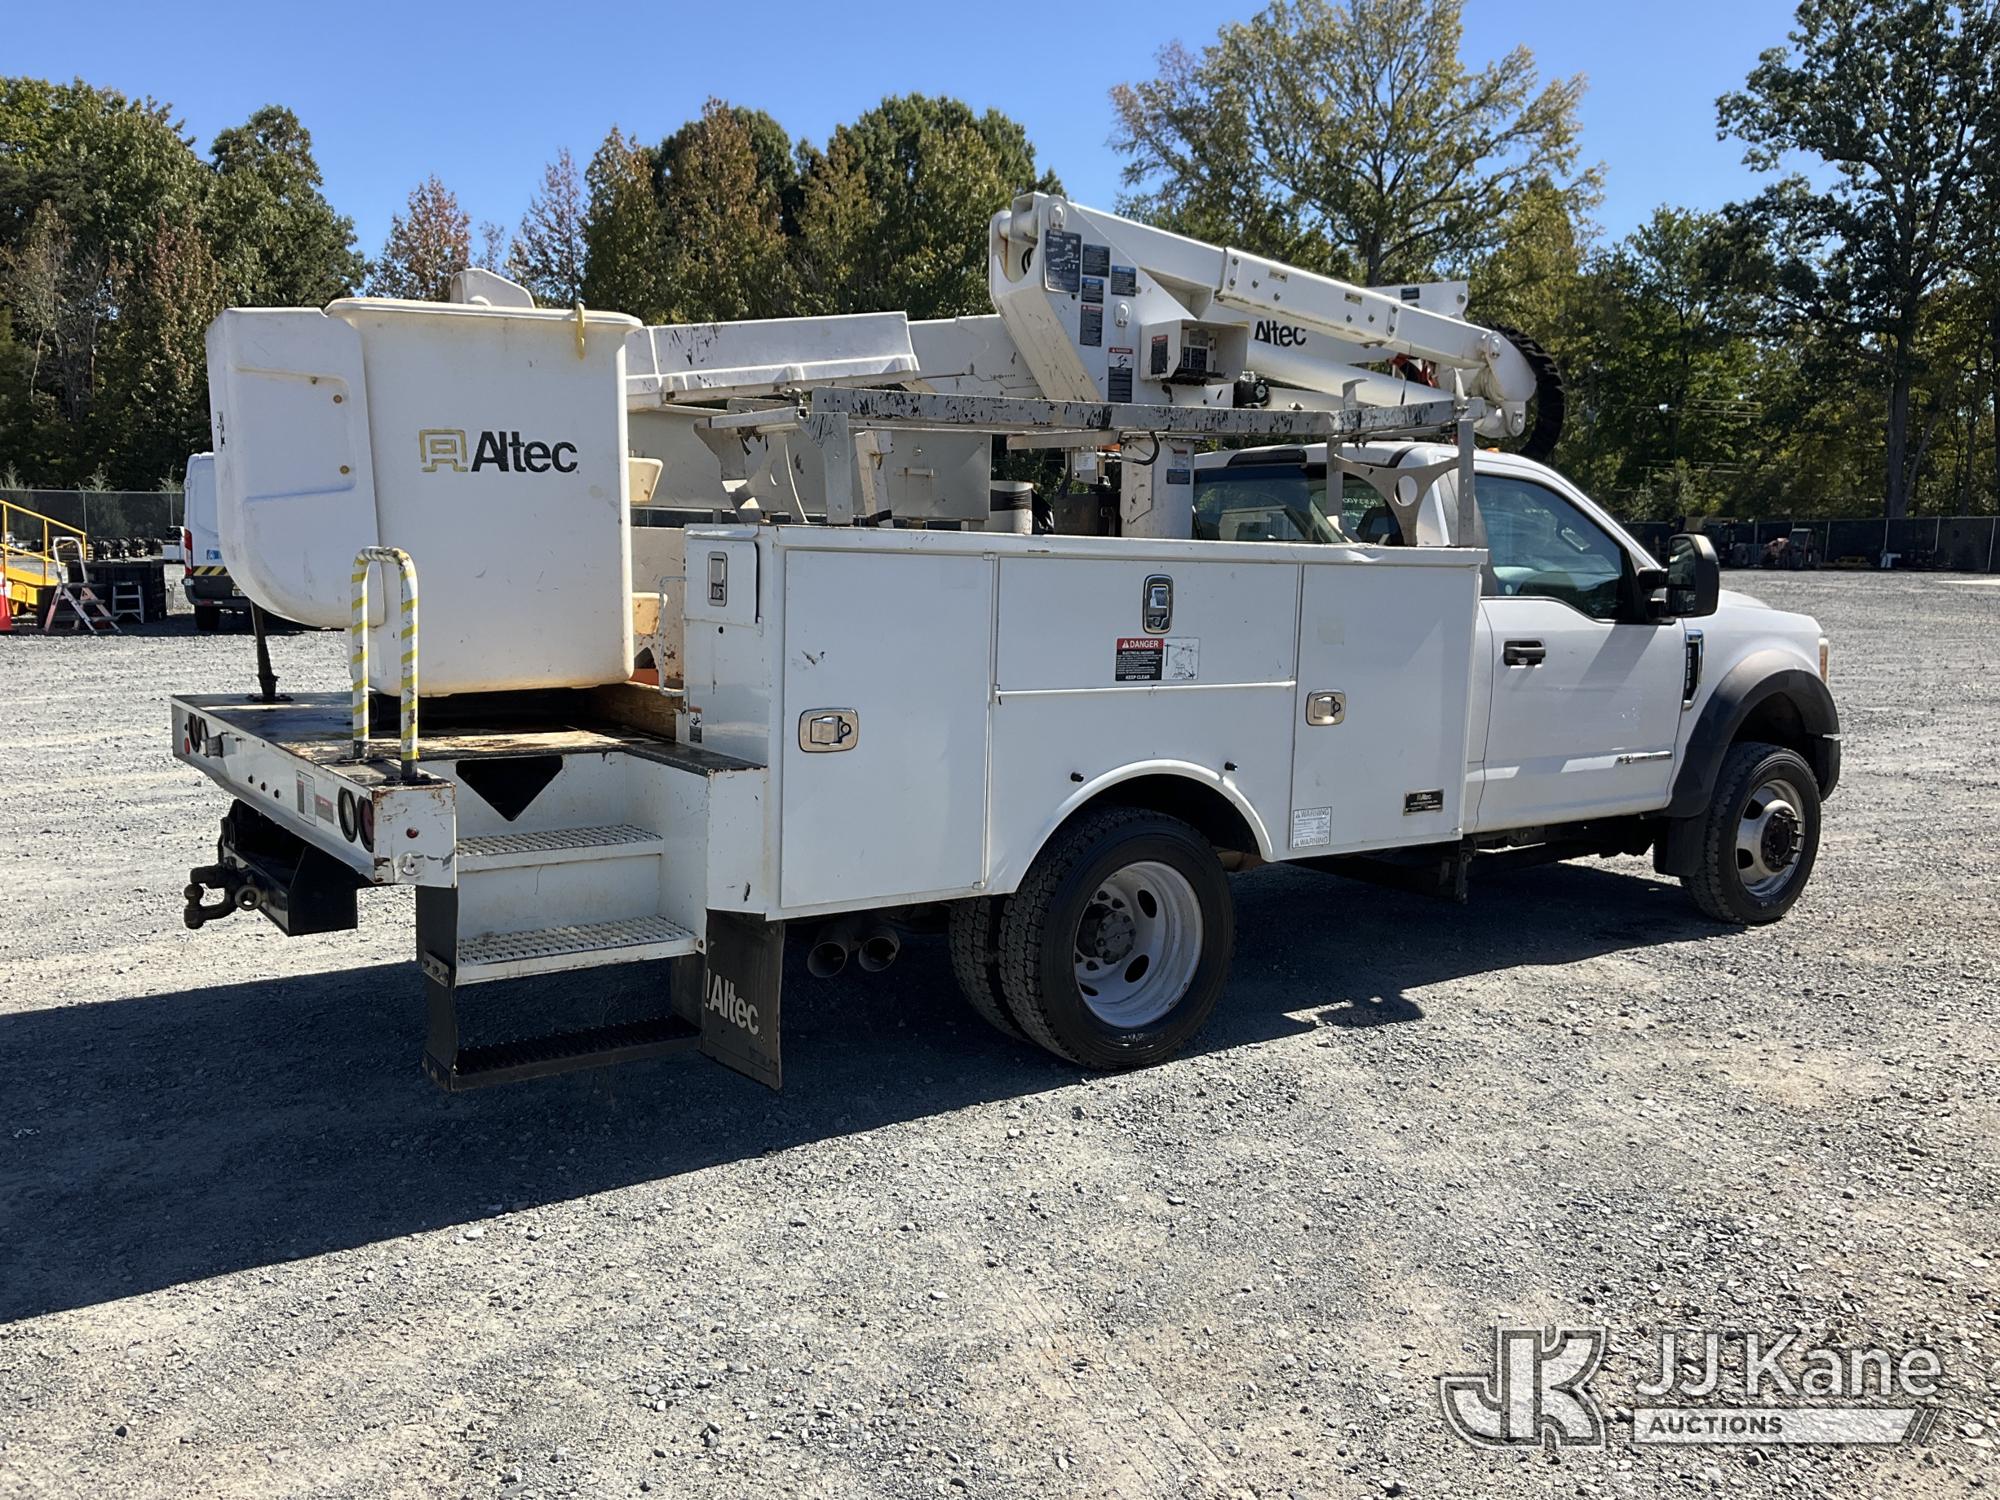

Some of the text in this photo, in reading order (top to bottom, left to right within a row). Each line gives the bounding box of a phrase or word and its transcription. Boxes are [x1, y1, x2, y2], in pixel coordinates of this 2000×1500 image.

[1254, 320, 1307, 347] Altec
[471, 431, 578, 473] Altec
[1129, 640, 1159, 649] DANGER
[709, 974, 759, 1035] Altec
